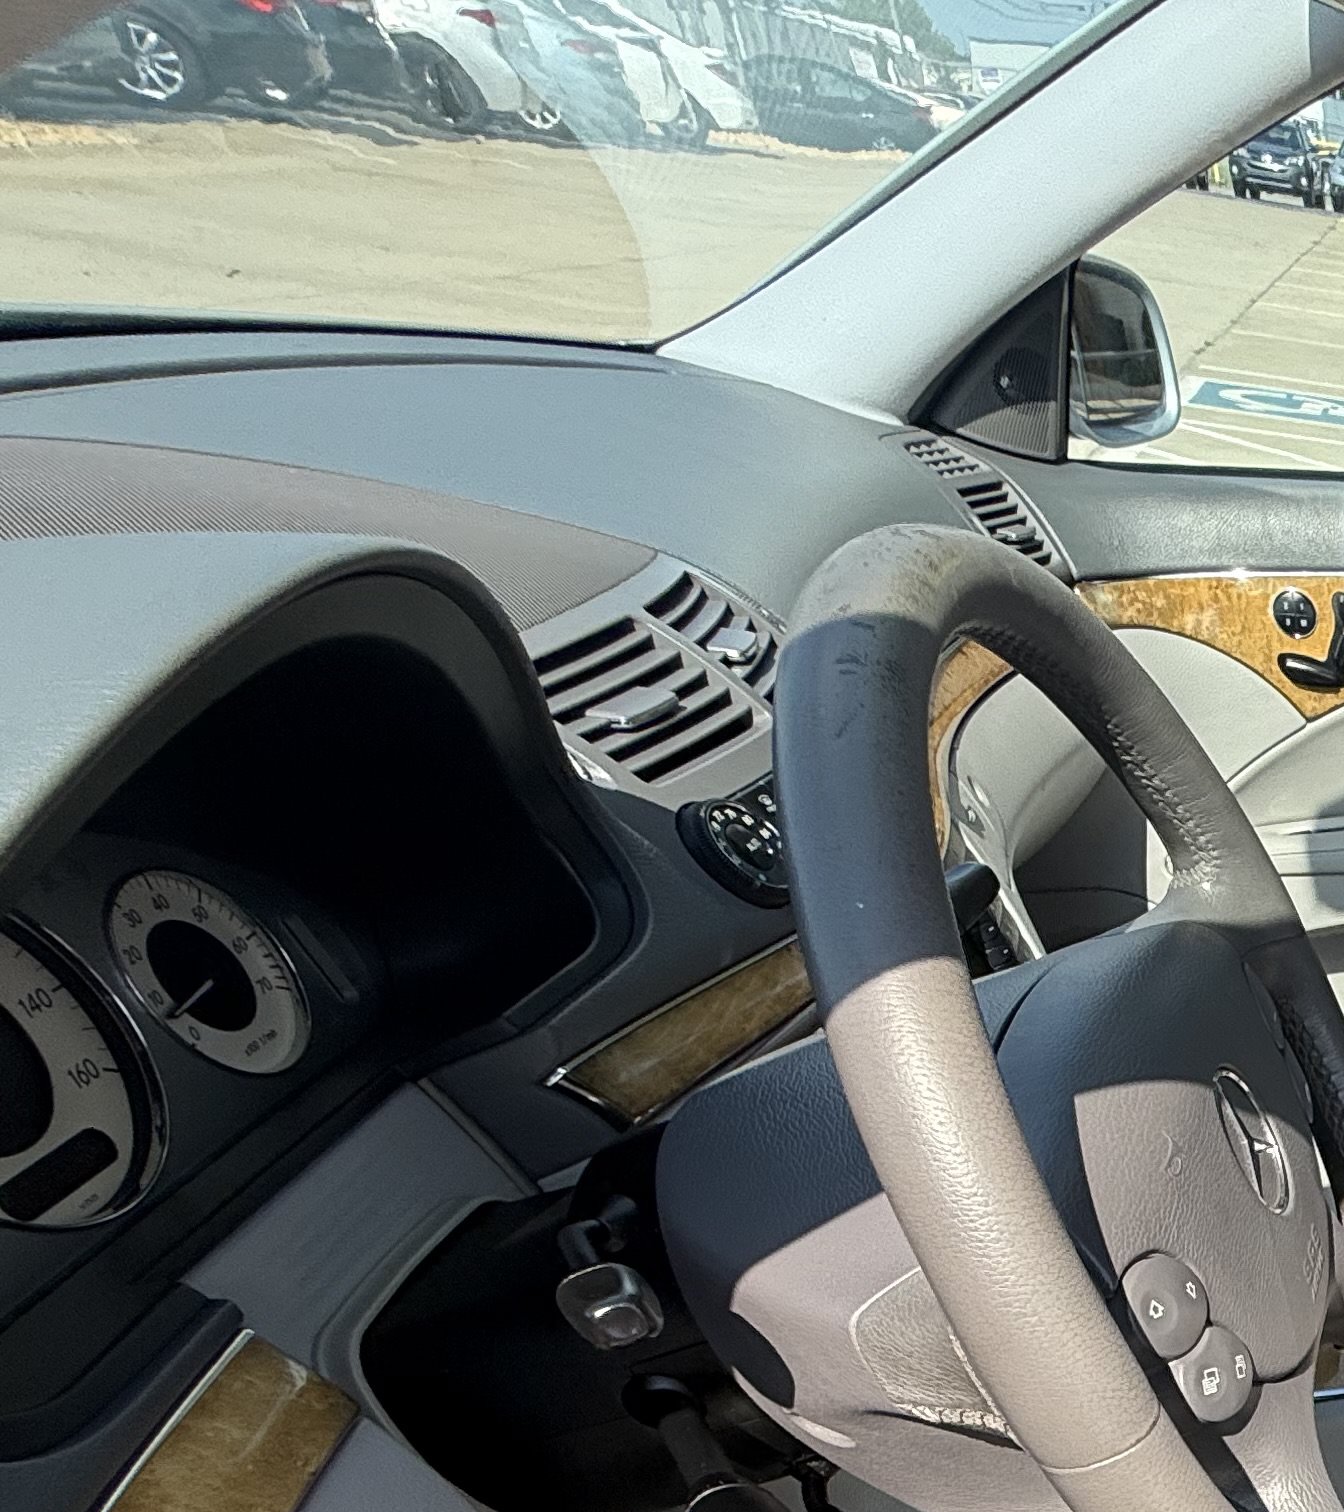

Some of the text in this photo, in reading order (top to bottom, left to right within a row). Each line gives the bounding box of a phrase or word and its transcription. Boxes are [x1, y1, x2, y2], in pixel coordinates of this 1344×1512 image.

[150, 893, 170, 913] 40
[191, 903, 210, 925] 50
[122, 908, 144, 929] 30
[122, 944, 142, 966] 20
[231, 933, 251, 956] 60
[256, 974, 274, 995] 70
[16, 987, 55, 1021] 140
[189, 1025, 202, 1042] 0
[66, 1056, 102, 1091] 160
